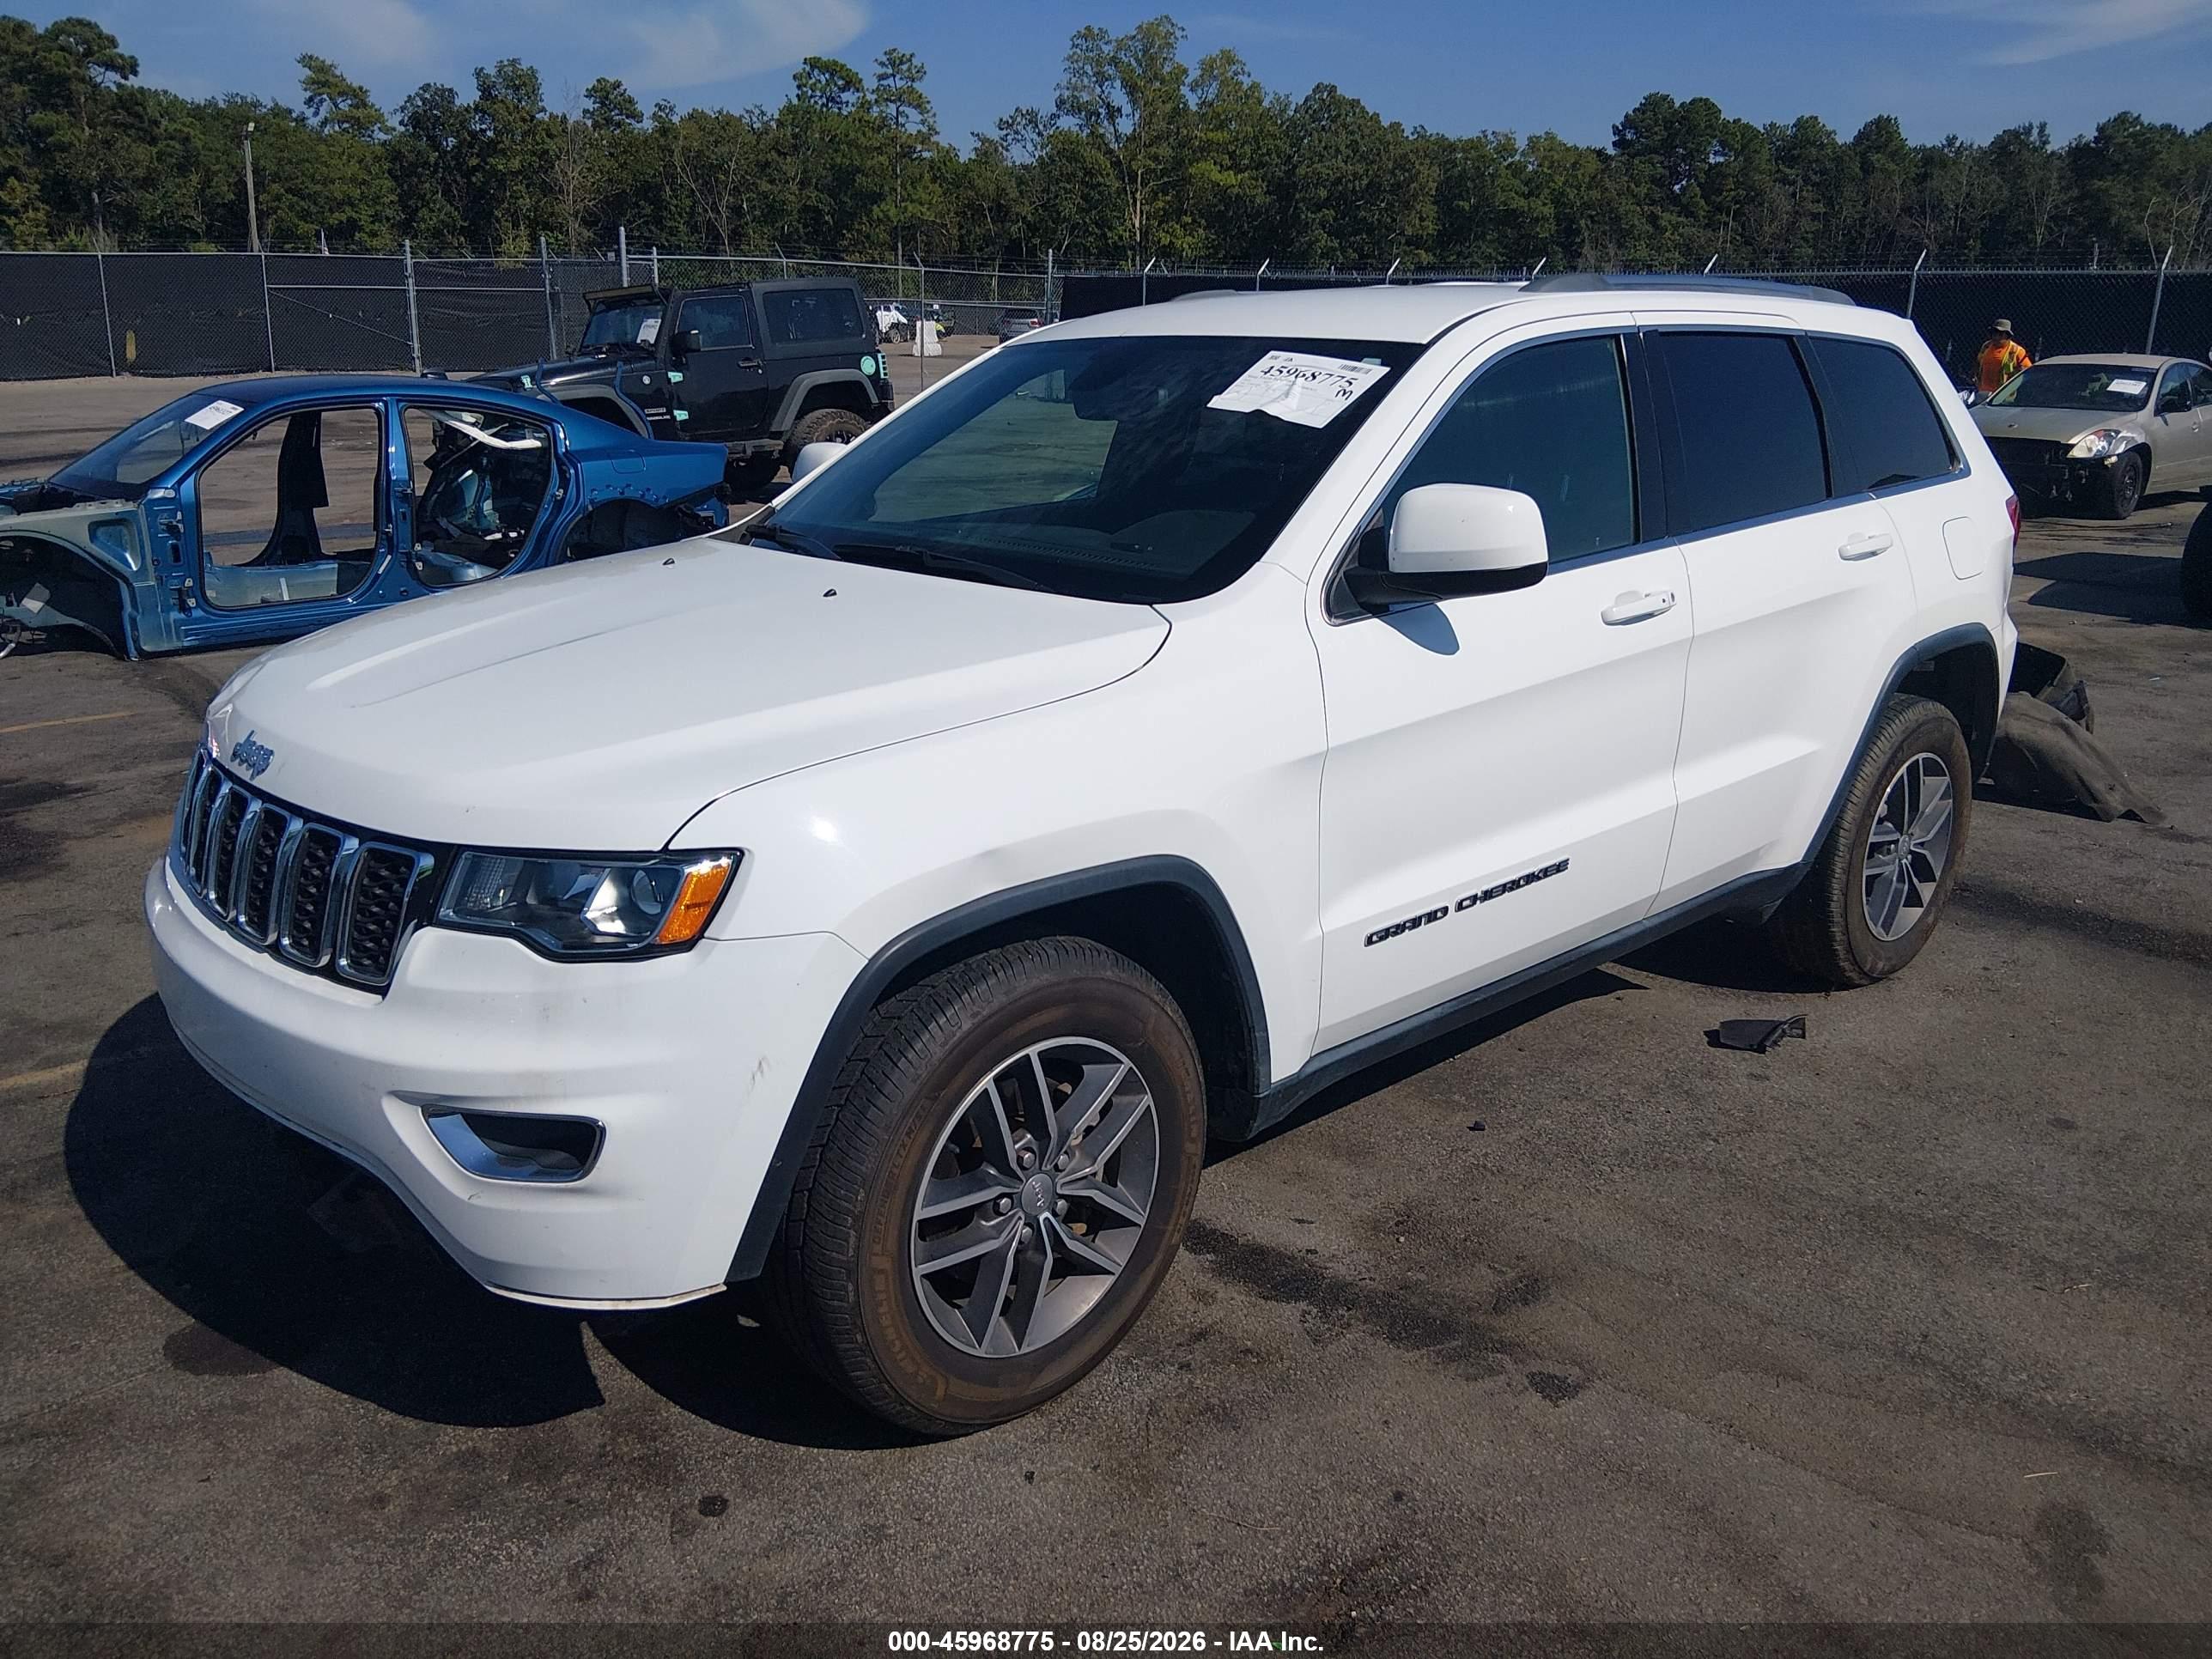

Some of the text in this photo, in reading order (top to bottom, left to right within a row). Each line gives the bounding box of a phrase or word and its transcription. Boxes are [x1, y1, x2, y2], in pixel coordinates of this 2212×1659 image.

[1260, 365, 1358, 388] 45968775
[1364, 858, 1571, 947] GRAND CHEROKEE
